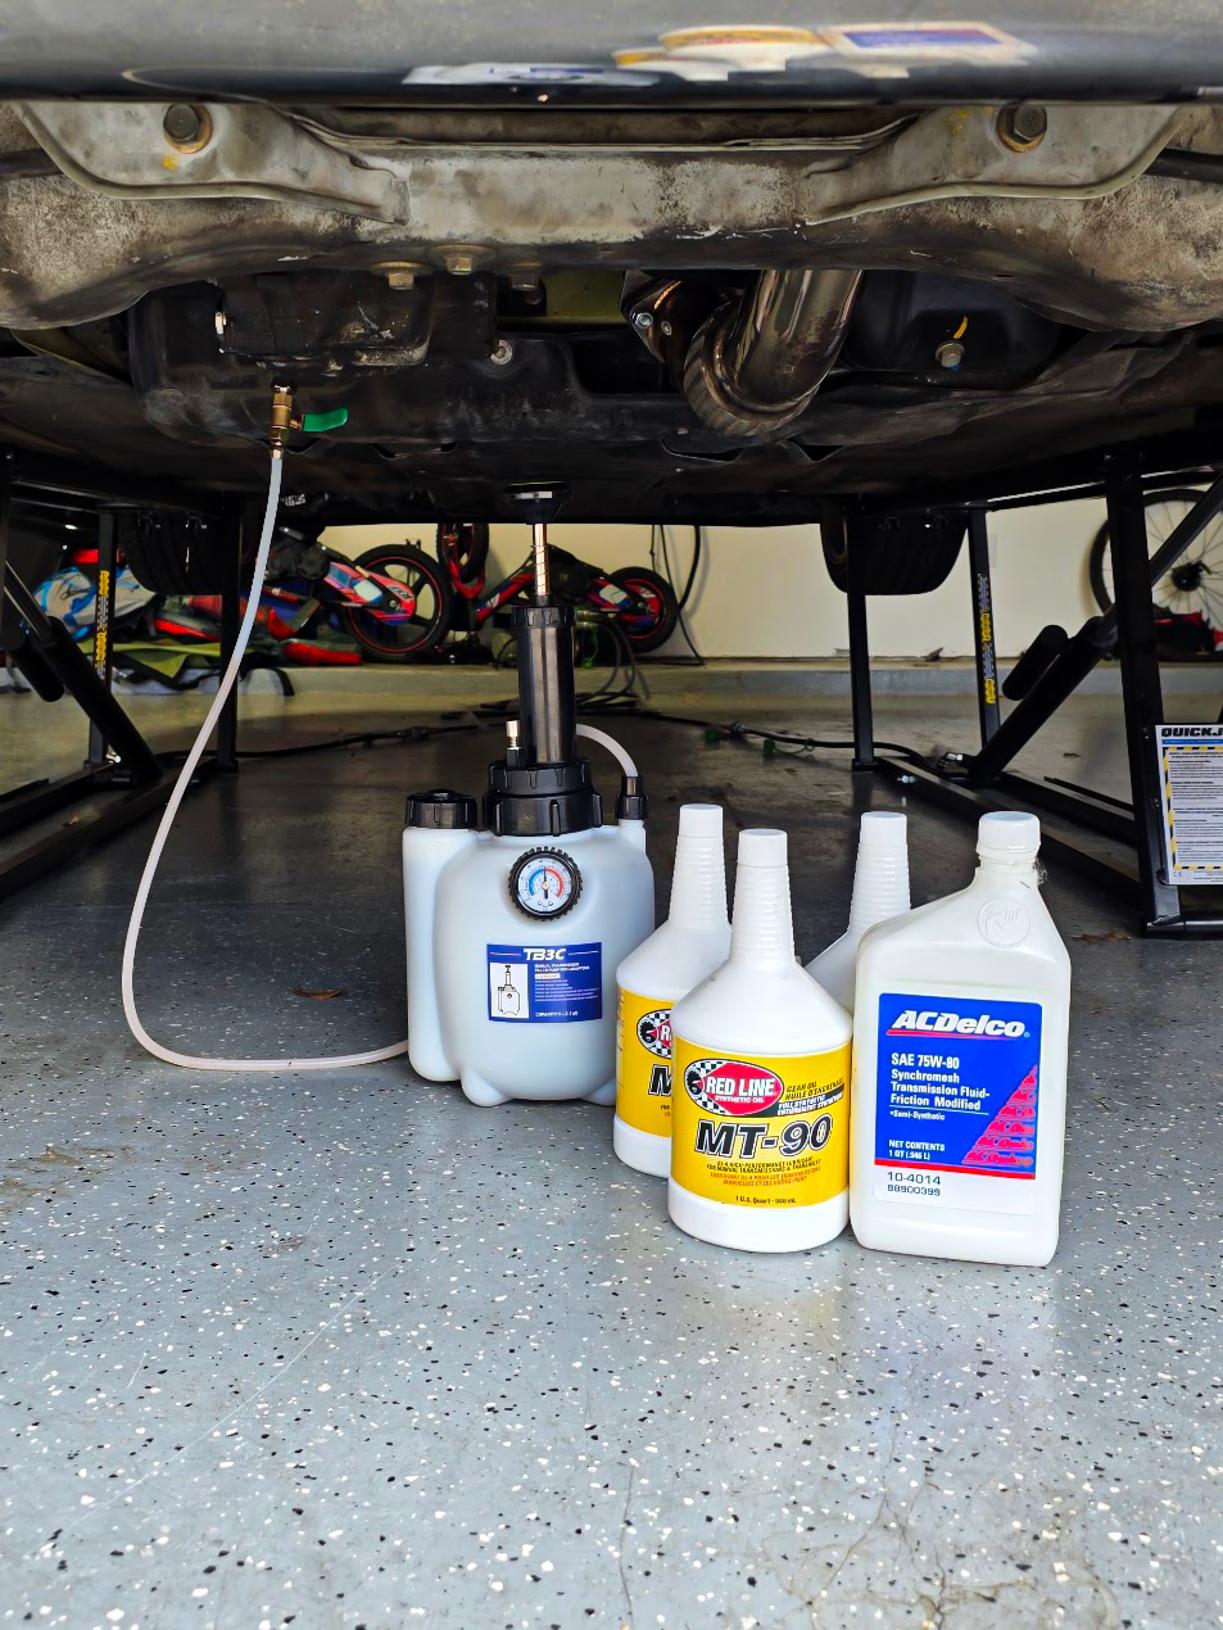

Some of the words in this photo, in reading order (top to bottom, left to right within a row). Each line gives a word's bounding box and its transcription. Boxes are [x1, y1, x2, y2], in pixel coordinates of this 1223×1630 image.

[523, 948, 566, 961] TB3C
[891, 1009, 1026, 1038] ACDelco
[891, 1052, 915, 1066] SAE
[891, 1069, 960, 1084] Synchromesh
[705, 1076, 736, 1096] RED
[738, 1078, 776, 1097] LINE
[890, 1081, 958, 1096] Transmission
[960, 1085, 991, 1099] Fluid-
[890, 1093, 930, 1106] Friction
[934, 1096, 982, 1111] Modified
[695, 1113, 833, 1159] MT-90
[888, 1139, 904, 1148] NET
[905, 1141, 946, 1152] CONTENTS
[894, 1150, 905, 1158] QT
[888, 1171, 941, 1185] 10-4014
